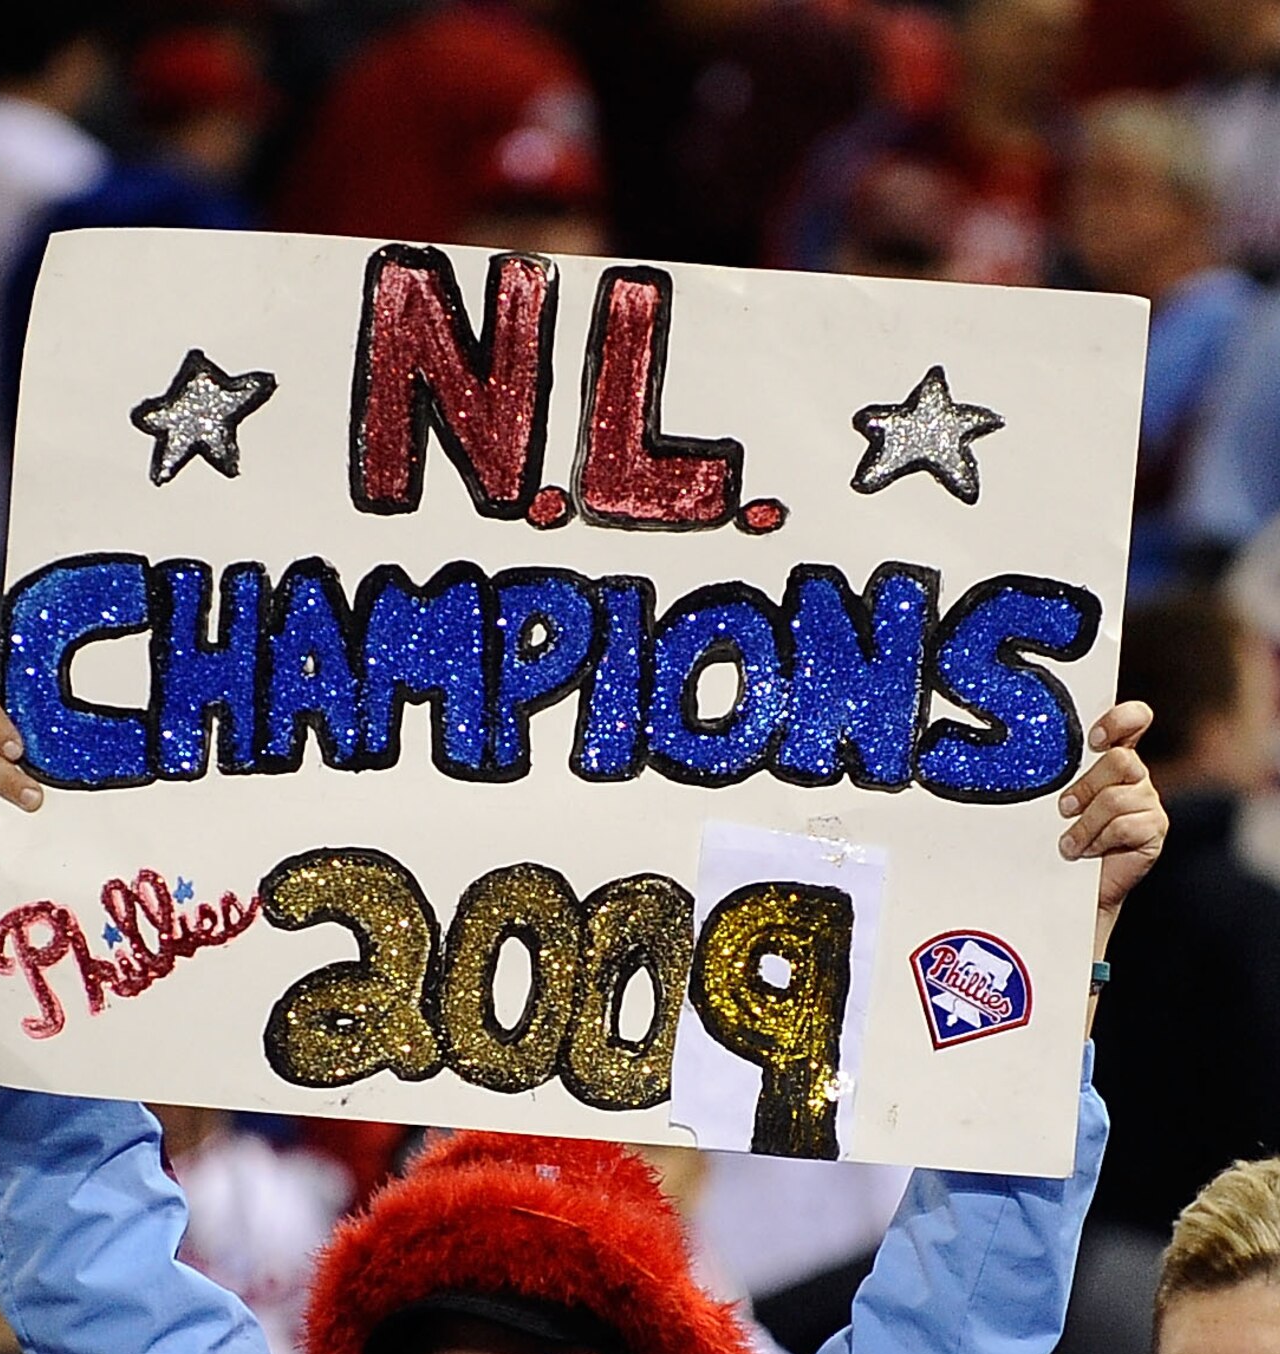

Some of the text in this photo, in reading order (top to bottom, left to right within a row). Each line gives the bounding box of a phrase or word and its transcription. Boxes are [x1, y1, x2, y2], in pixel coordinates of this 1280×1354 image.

[350, 242, 790, 532] N.L.
[258, 846, 856, 1162] 2009
[924, 943, 1014, 1019] Phillies
